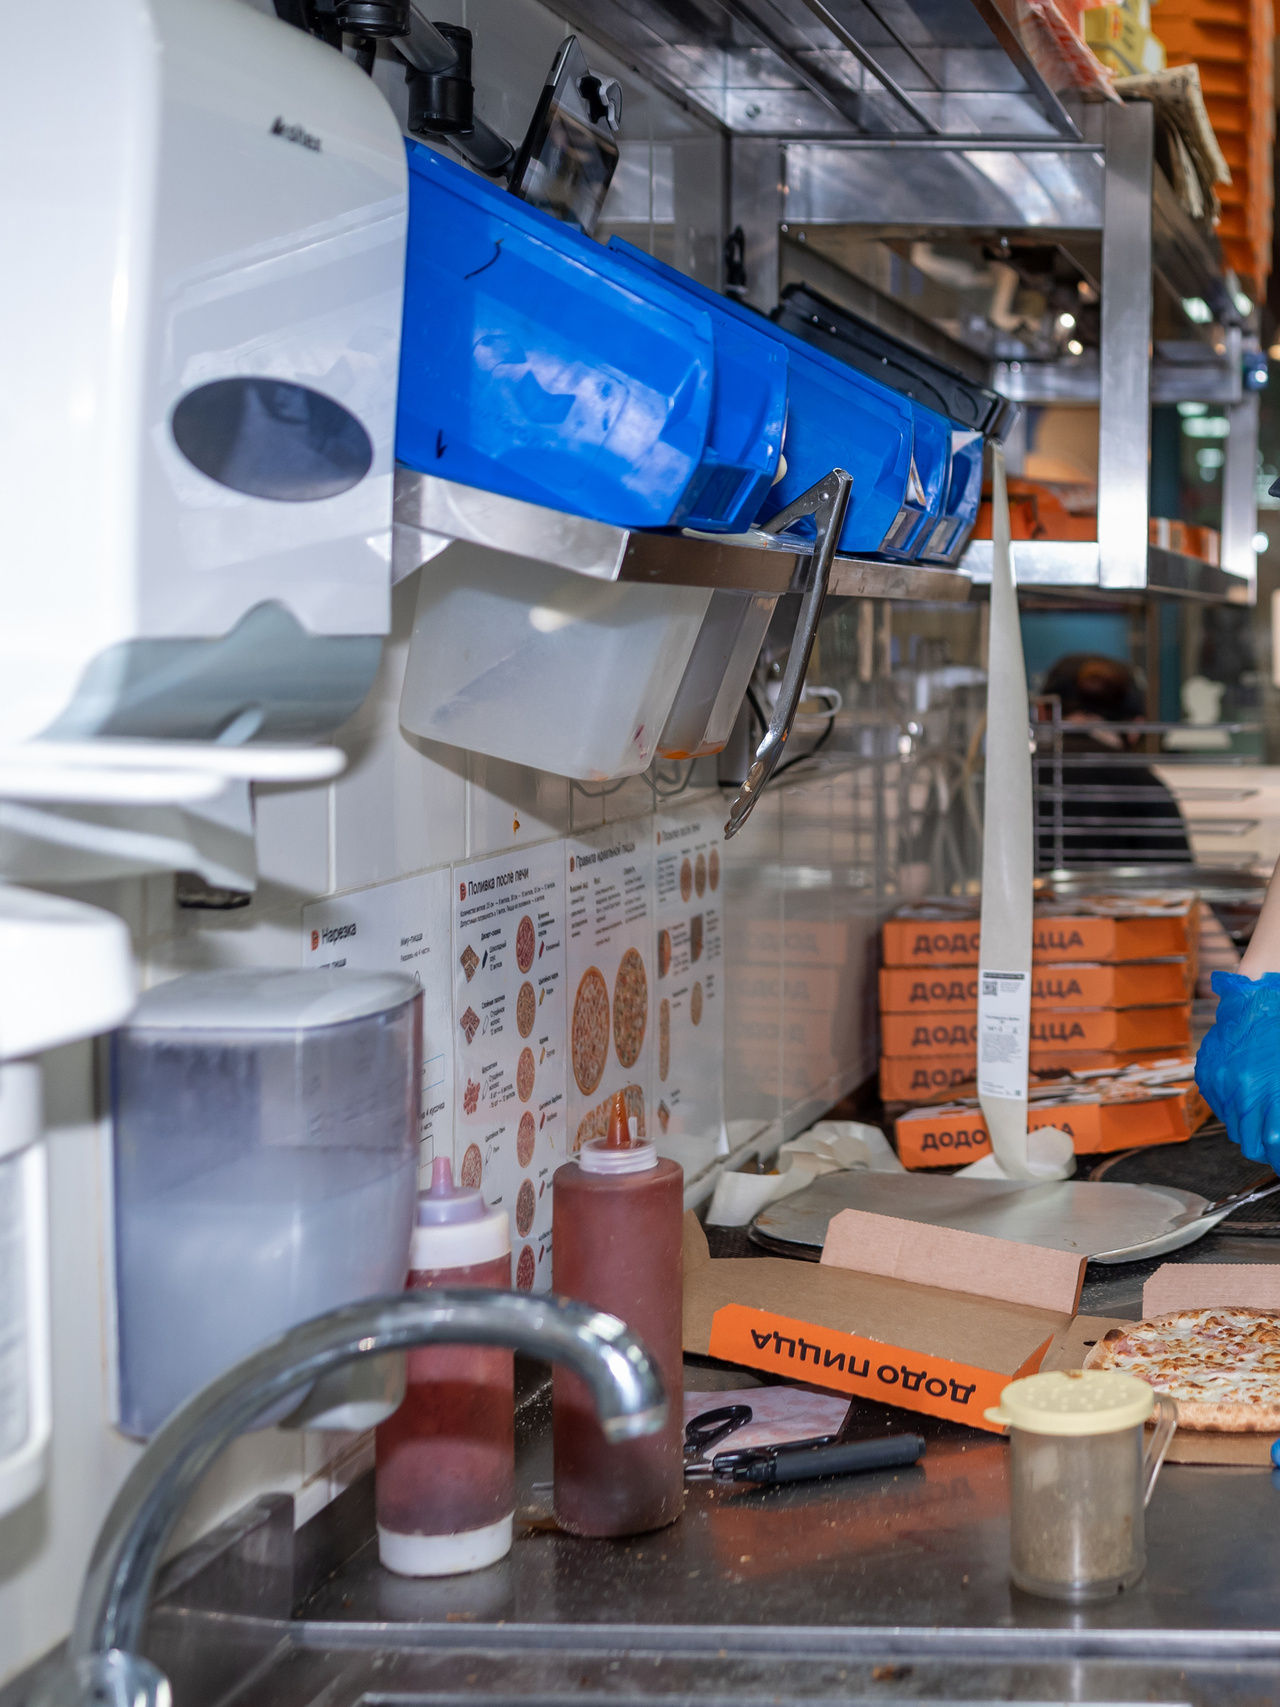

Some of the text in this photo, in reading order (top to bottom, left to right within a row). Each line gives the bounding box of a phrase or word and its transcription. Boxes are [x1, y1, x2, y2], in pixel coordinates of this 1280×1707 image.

[468, 876, 495, 896] Поливка
[496, 871, 514, 888] после
[515, 868, 529, 881] печи
[322, 923, 357, 945] Нарезка
[1033, 931, 1083, 949] ЦЦА
[1031, 979, 1082, 998] ЦЦА
[1030, 1022, 1085, 1042] ЦЦА
[921, 1129, 987, 1151] ДОДО
[751, 1329, 976, 1404] ДОДО ПИЦЦА
